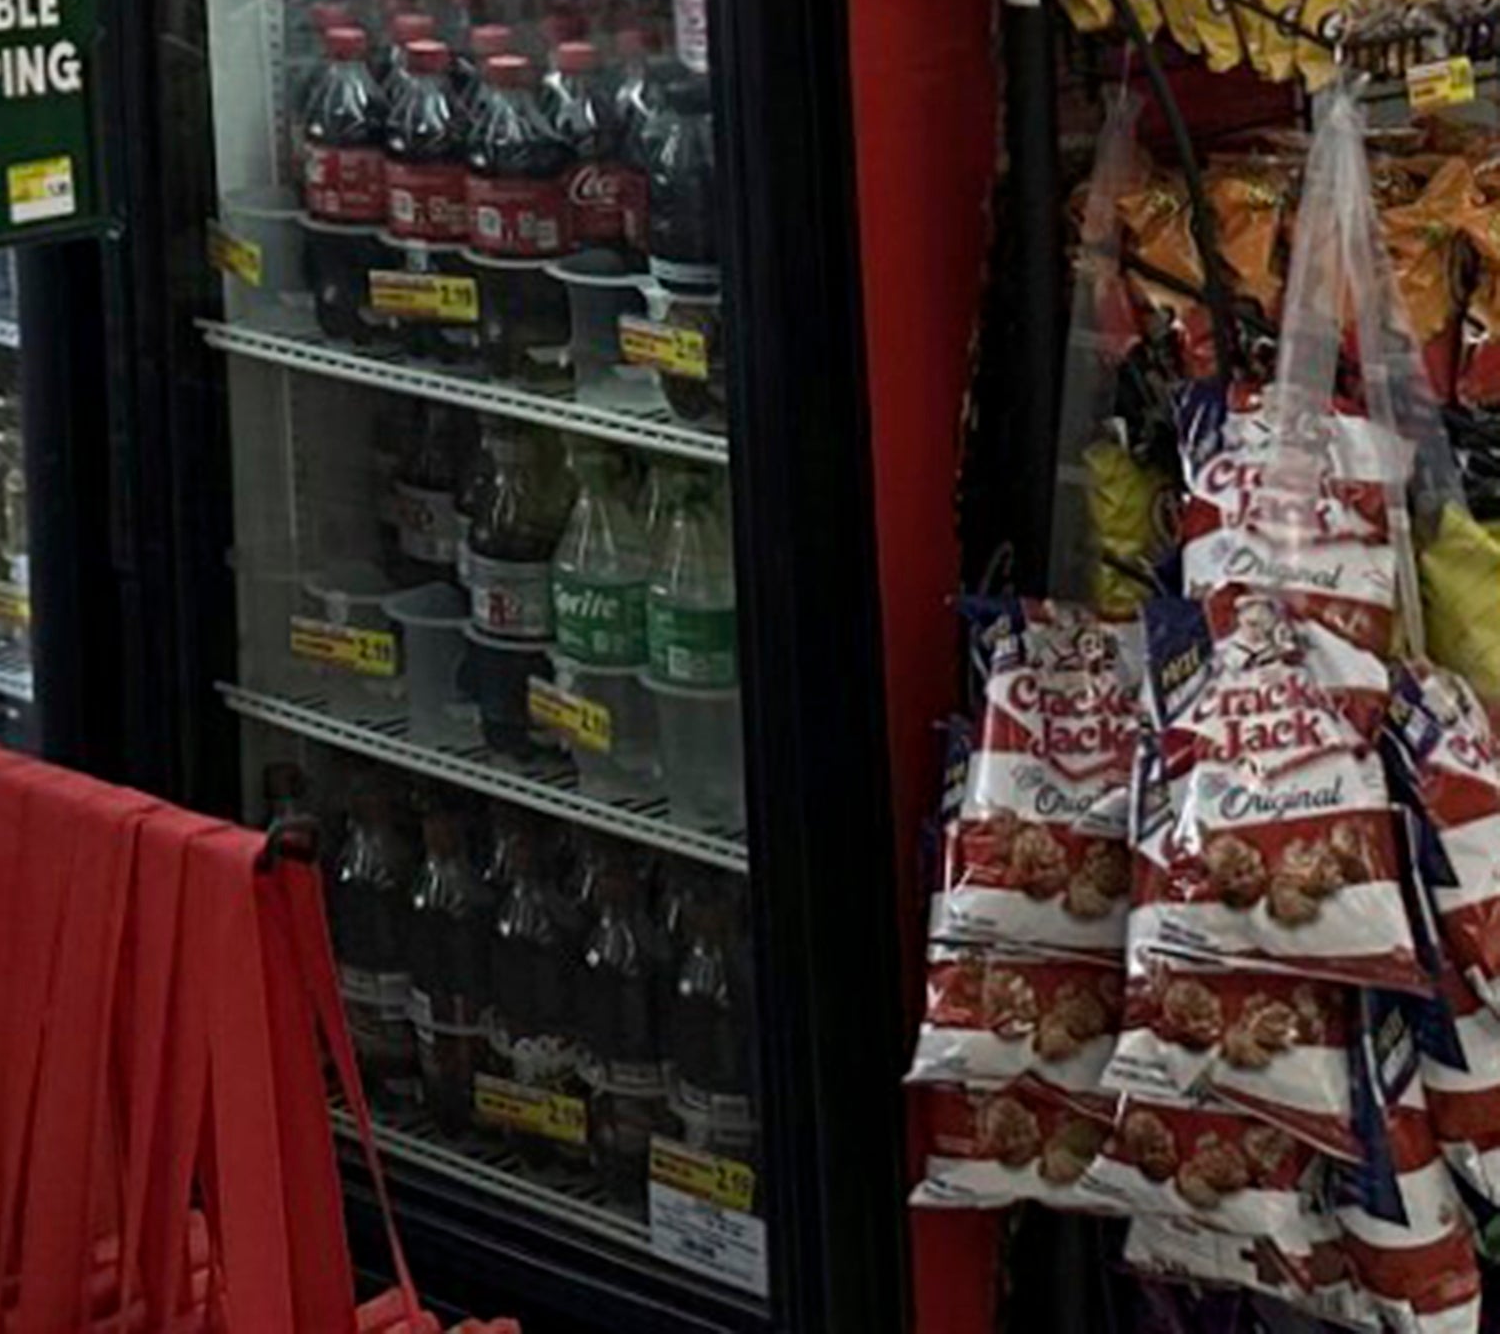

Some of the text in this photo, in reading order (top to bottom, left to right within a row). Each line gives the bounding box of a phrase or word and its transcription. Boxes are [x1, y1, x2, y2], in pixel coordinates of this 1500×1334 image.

[1222, 543, 1343, 590] Original
[1214, 707, 1324, 761] Jack
[1220, 776, 1344, 820] Original
